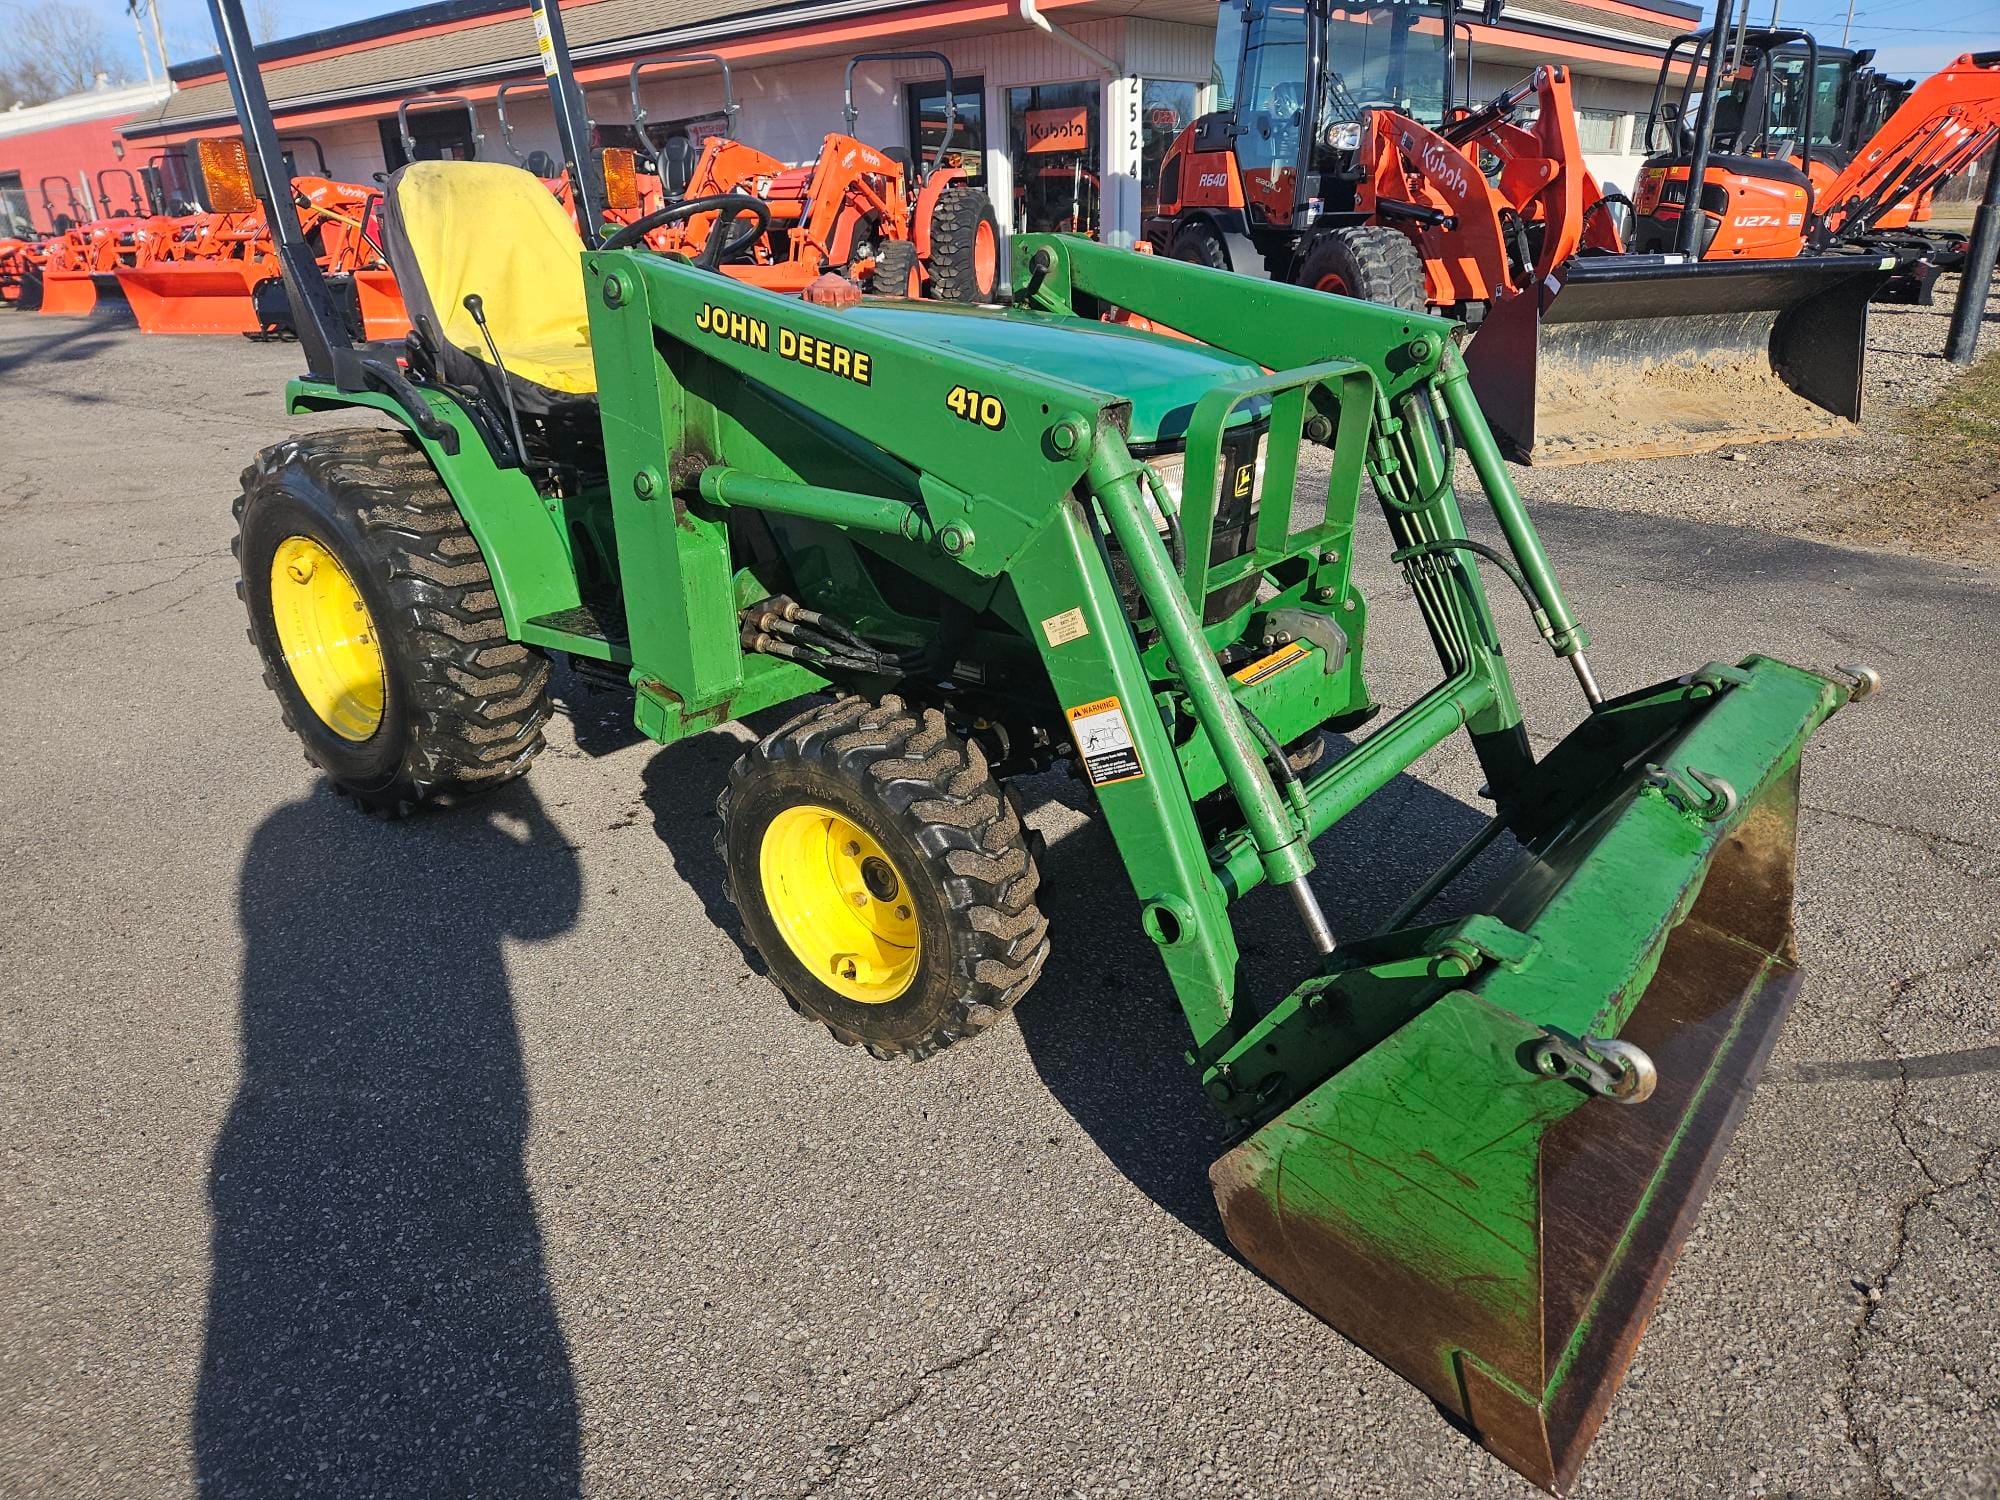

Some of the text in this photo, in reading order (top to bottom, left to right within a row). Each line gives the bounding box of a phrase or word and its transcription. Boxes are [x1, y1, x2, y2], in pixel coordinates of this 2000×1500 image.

[1029, 120, 1085, 140] Kubota
[1199, 173, 1228, 187] R640
[1421, 141, 1469, 199] Kubota
[1733, 215, 1782, 228] U27-4
[695, 302, 873, 387] JOHN DEERE
[945, 384, 1007, 432] 410
[1080, 700, 1115, 716] WARNING
